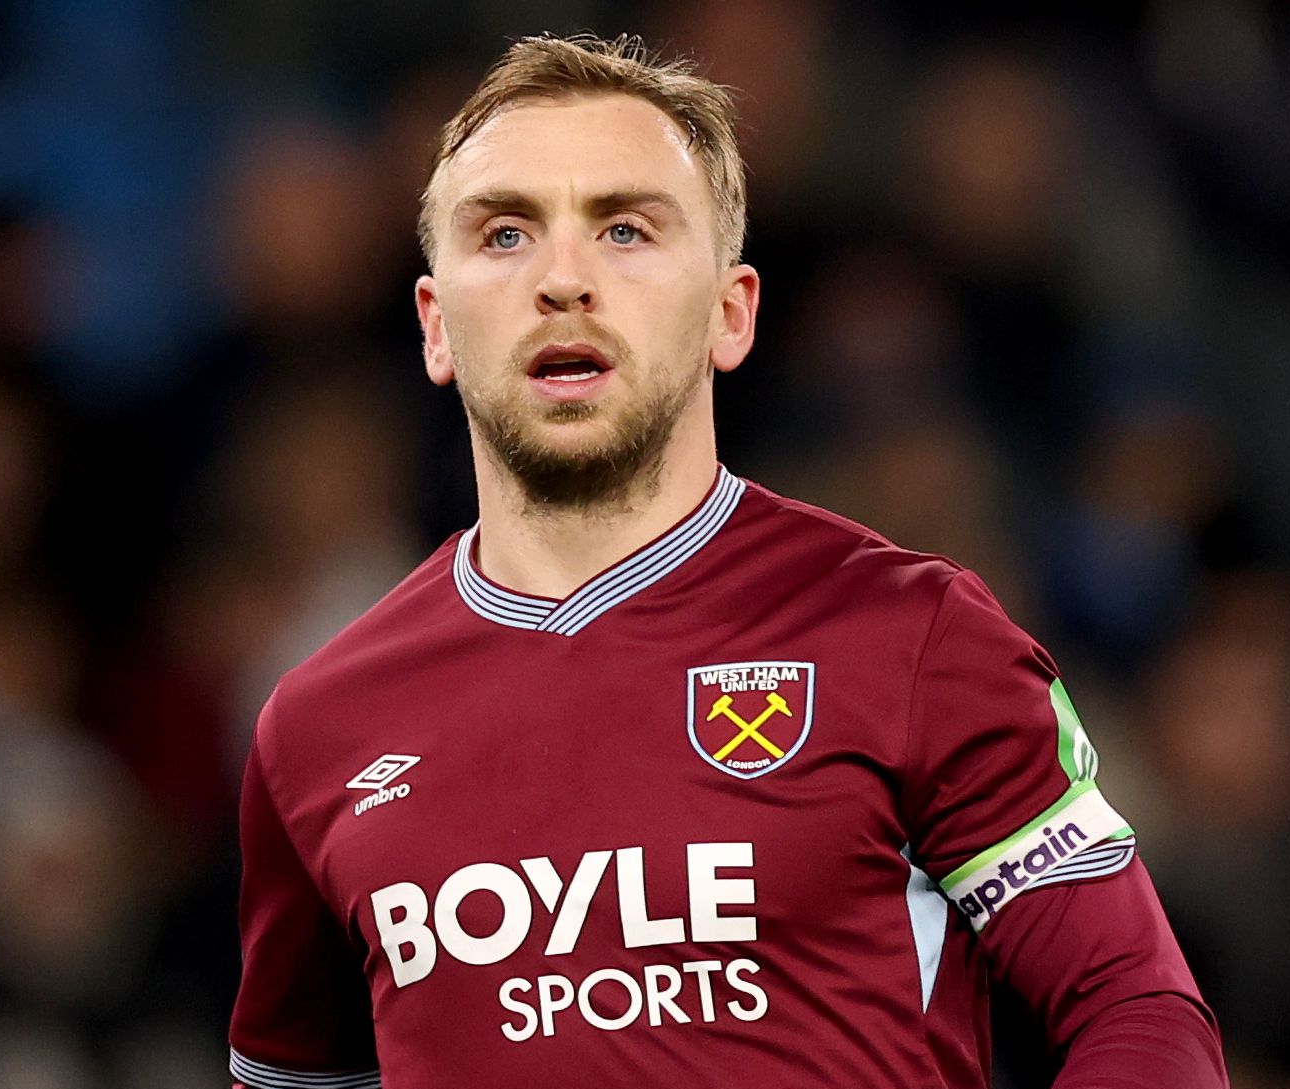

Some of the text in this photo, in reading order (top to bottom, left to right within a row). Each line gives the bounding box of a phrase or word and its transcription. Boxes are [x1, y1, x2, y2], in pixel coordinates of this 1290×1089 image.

[700, 667, 799, 686] WEST HAM
[721, 680, 778, 692] UNITED
[726, 758, 771, 769] LONDON
[354, 783, 411, 816] umbro
[959, 822, 1088, 918] aptain
[371, 842, 757, 988] BOYLE
[499, 958, 768, 1042] SPORTS
